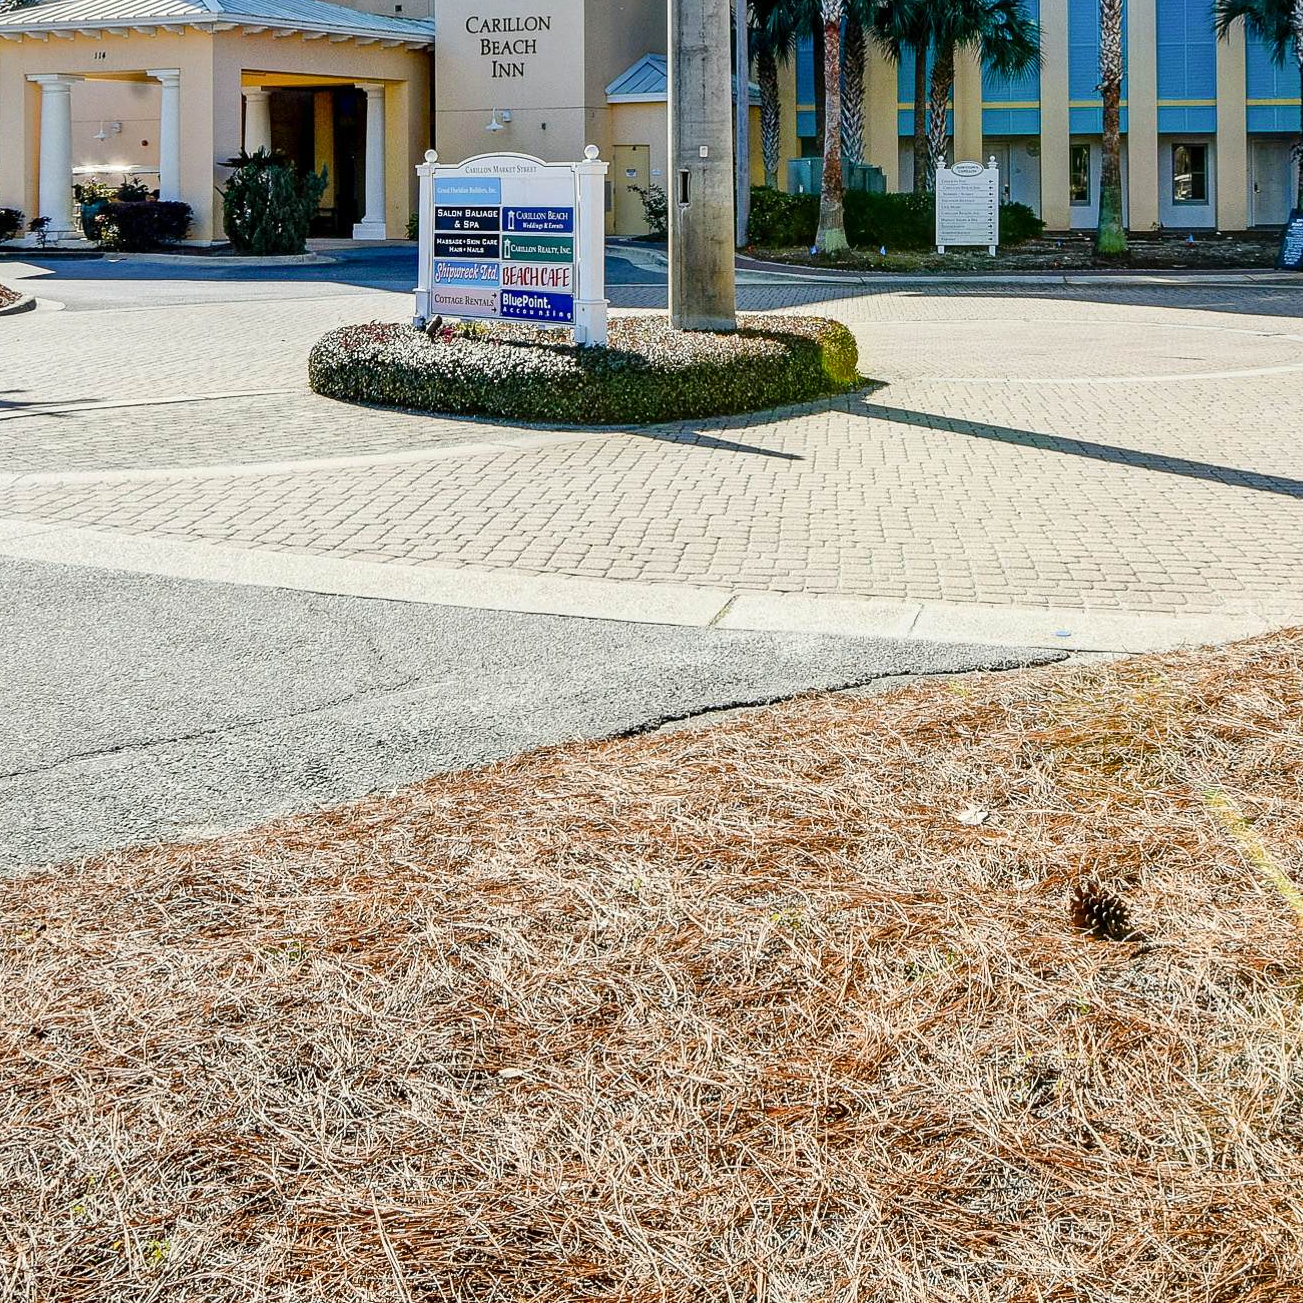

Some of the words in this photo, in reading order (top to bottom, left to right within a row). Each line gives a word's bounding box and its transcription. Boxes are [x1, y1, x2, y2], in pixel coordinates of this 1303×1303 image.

[466, 16, 551, 34] CARILLON
[480, 39, 537, 56] BEACH
[492, 60, 525, 78] INN
[465, 166, 492, 174] CARILLON
[493, 165, 516, 173] MARKET
[517, 164, 537, 173] STREET
[437, 209, 464, 217] SALON
[465, 209, 498, 218] BALIAGE
[516, 210, 547, 220] CARILLON
[548, 211, 568, 220] BEACH
[454, 220, 461, 228] &
[463, 220, 480, 229] SPA
[511, 244, 536, 253] CARILLON
[435, 263, 478, 283] Shipwreck
[480, 264, 499, 281] Ltd.
[502, 266, 538, 286] BEACH
[540, 267, 570, 287] CAFE
[435, 294, 463, 305] COTTAGE
[465, 296, 494, 307] RENTALS
[502, 293, 551, 309] BluePoint.
